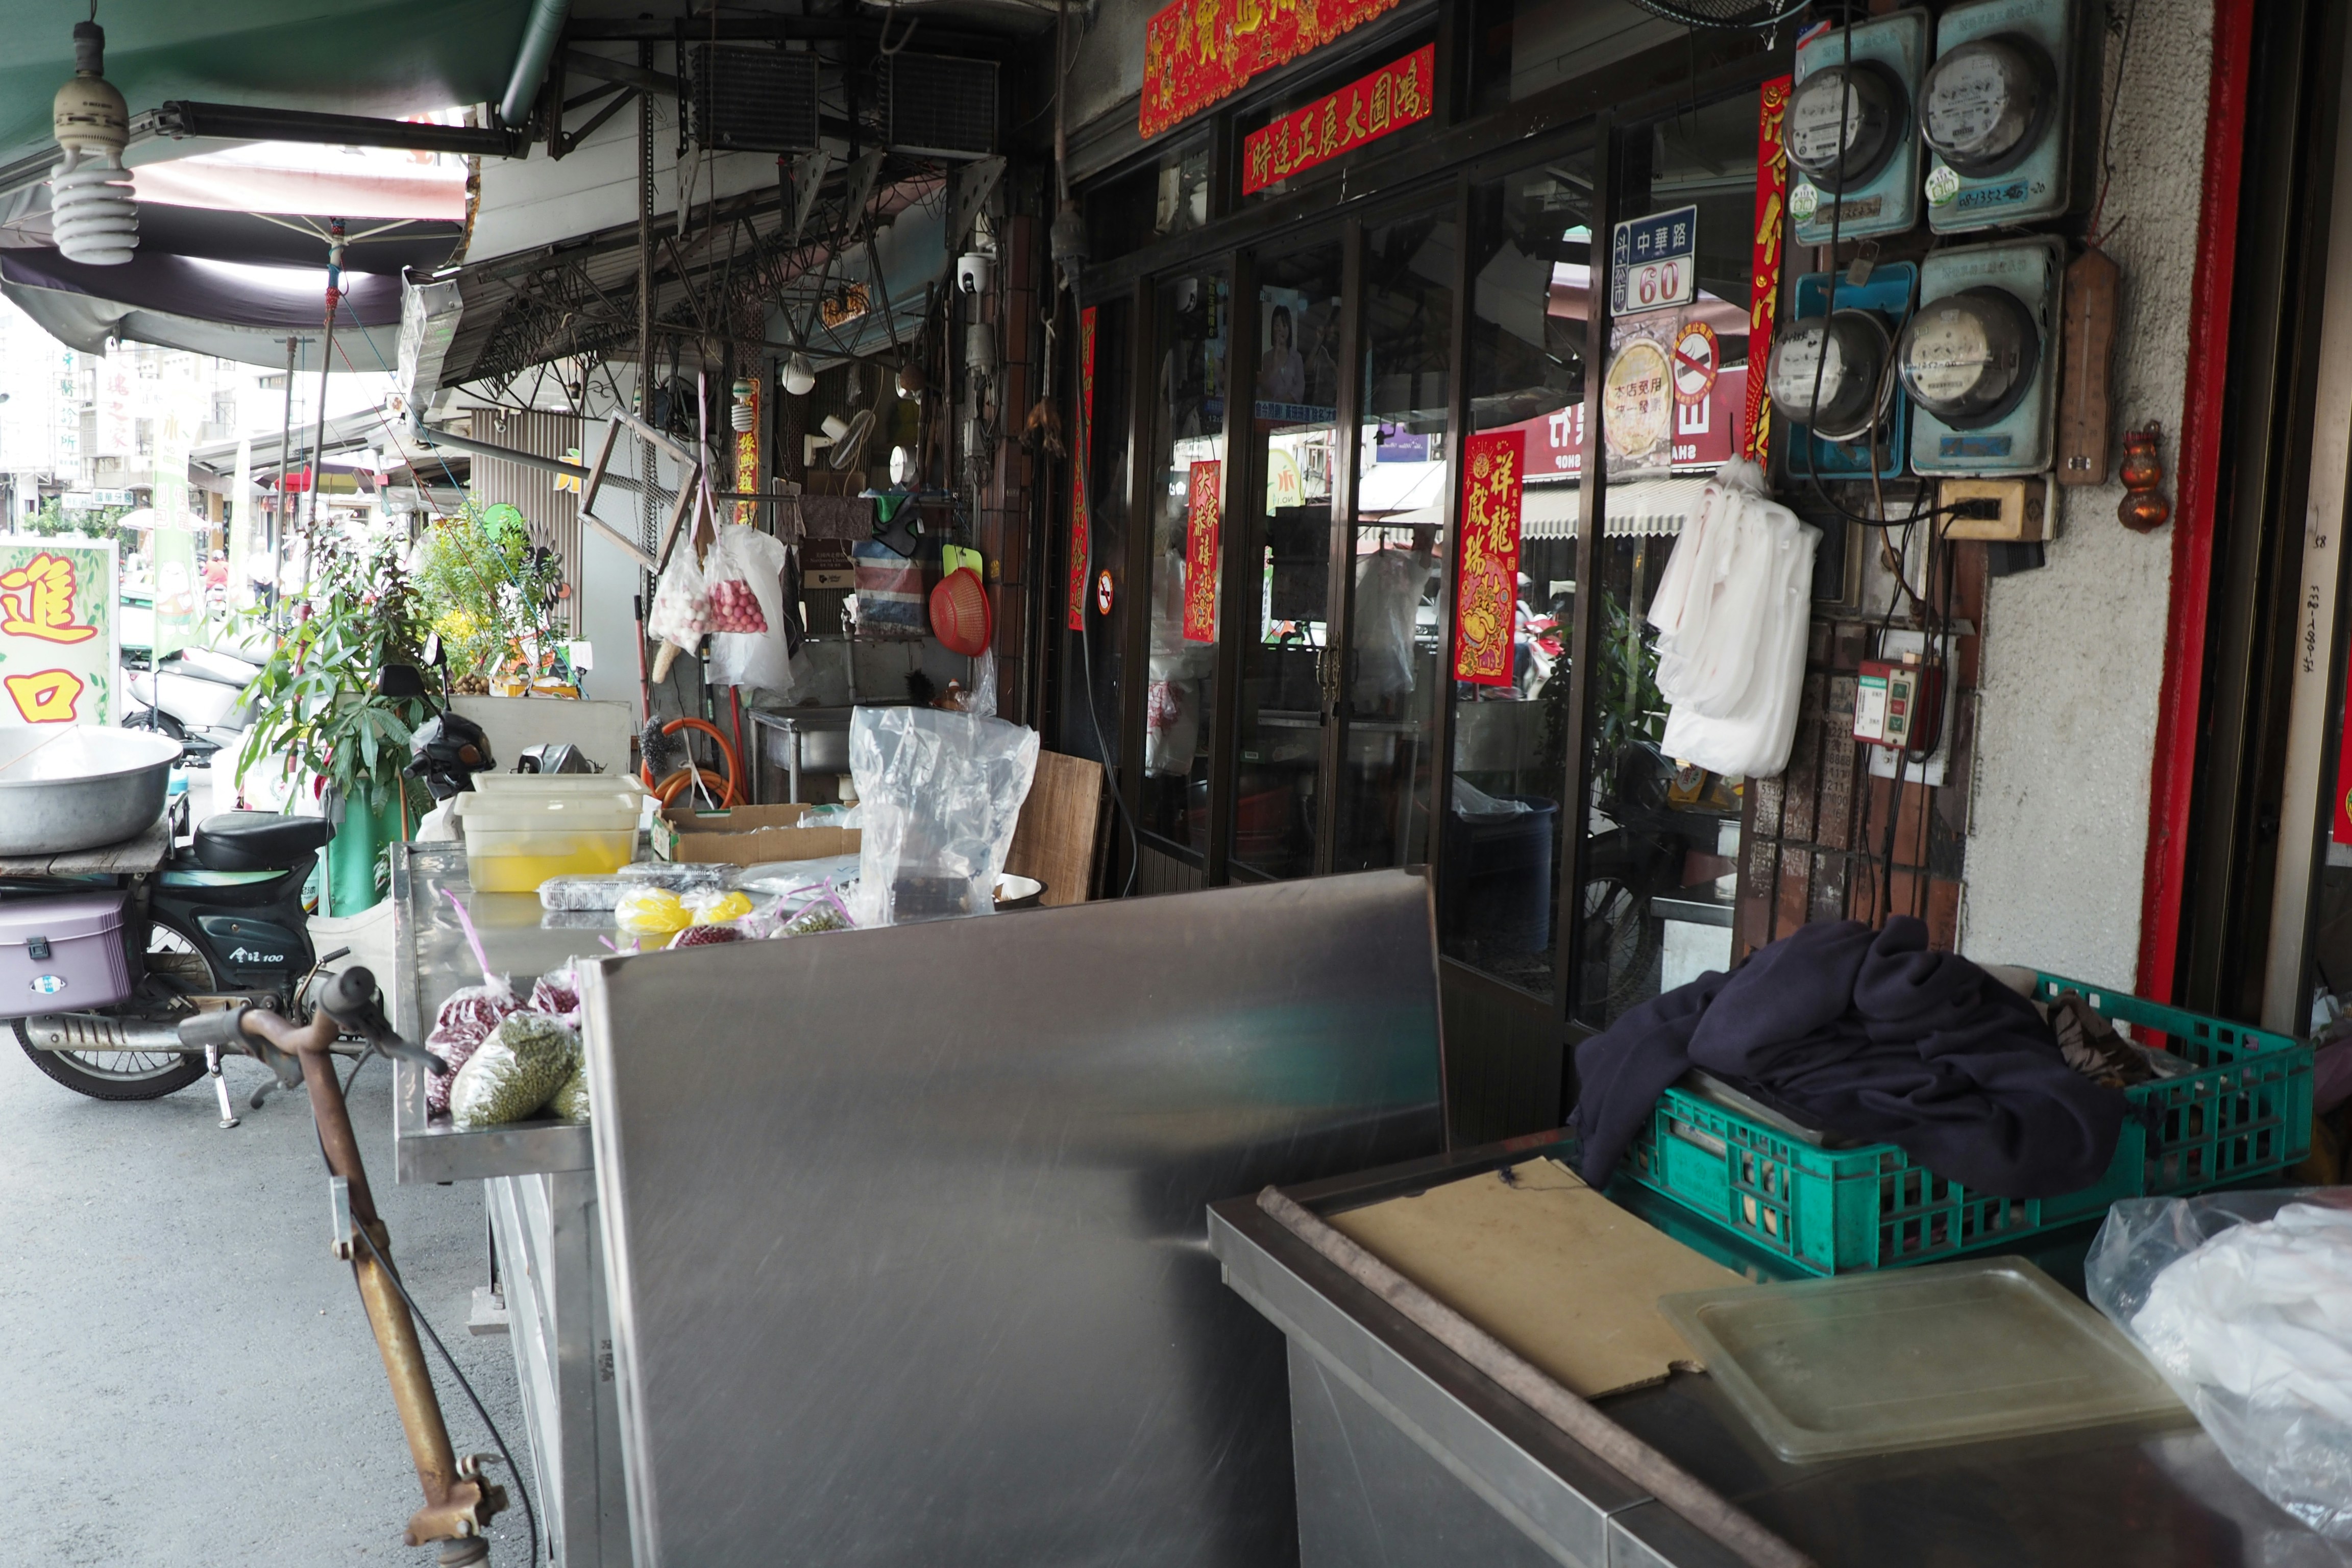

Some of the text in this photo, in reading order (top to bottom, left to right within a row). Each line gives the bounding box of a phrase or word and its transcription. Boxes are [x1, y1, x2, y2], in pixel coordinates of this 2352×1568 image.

[1637, 223, 1686, 254] 中華路
[1614, 234, 1627, 304] 斗六市
[1639, 261, 1679, 304] 60
[1614, 377, 1662, 399] 本店免用
[1, 552, 98, 723] 進口
